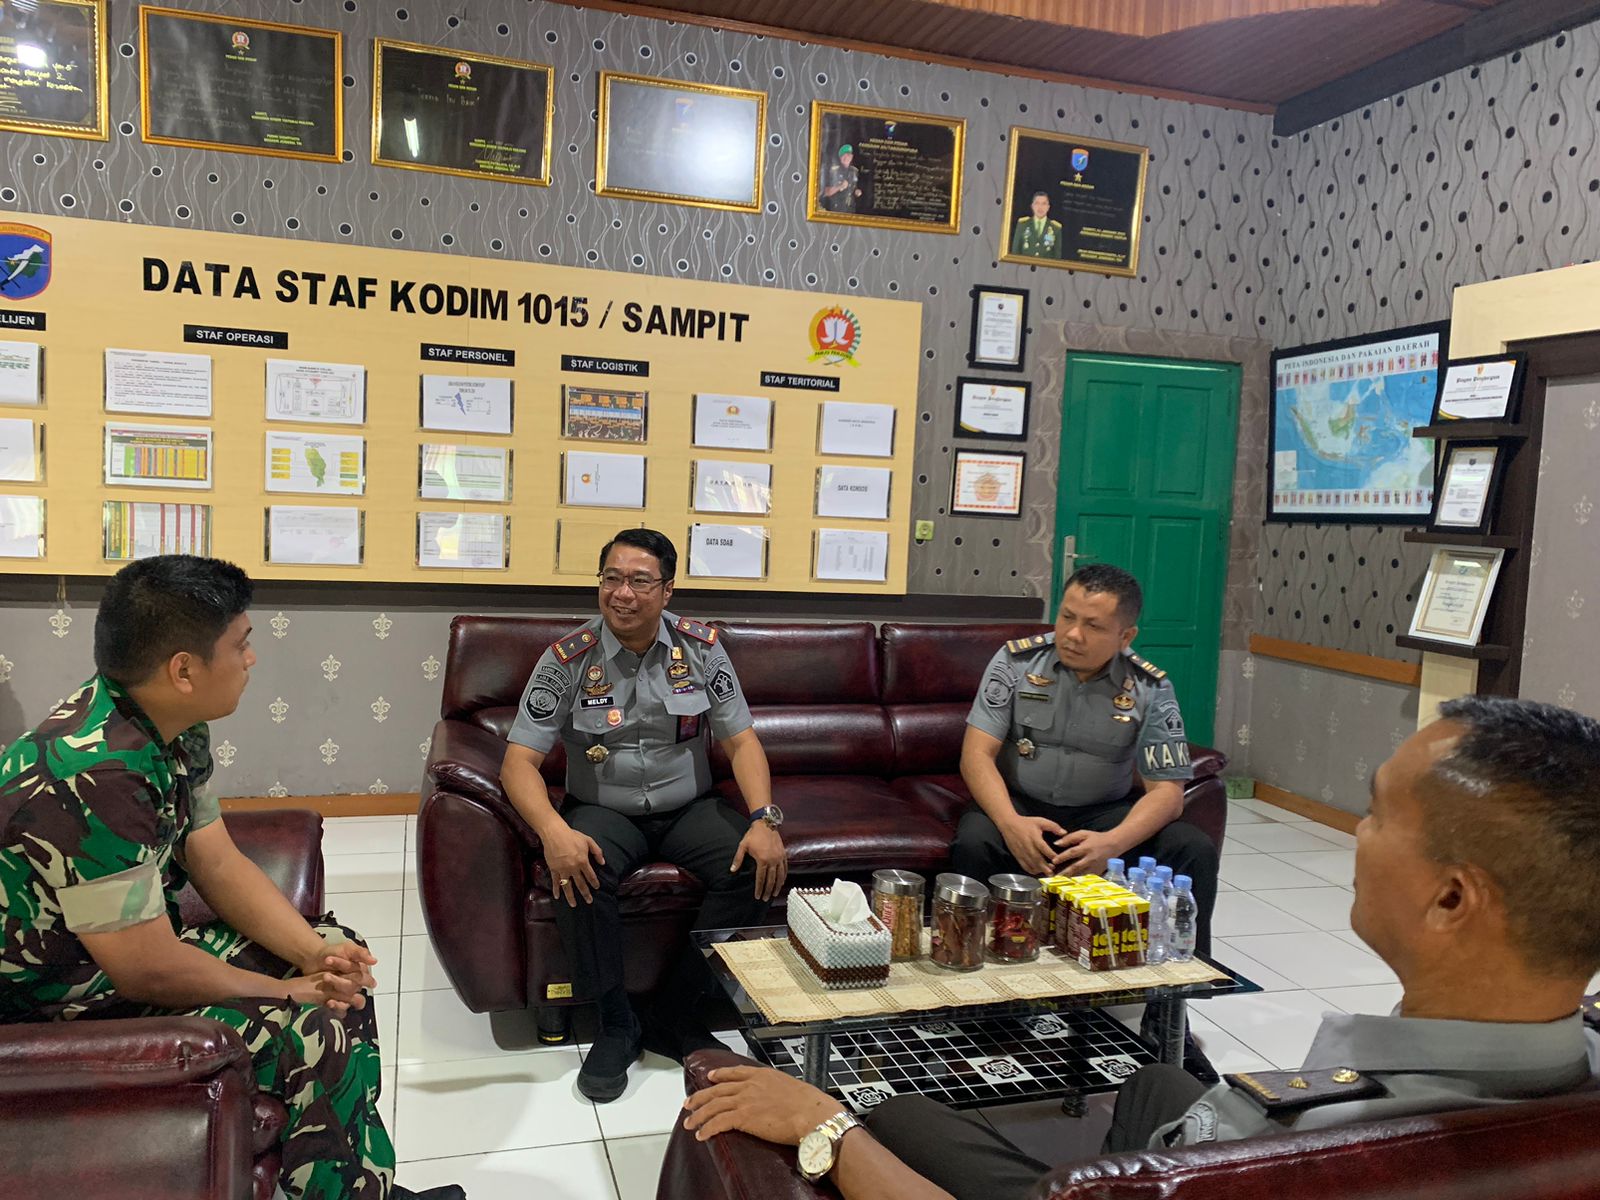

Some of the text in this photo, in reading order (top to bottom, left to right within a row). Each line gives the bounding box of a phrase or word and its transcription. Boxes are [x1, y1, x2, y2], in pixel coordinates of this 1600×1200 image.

[143, 257, 750, 343] DATA STAF KODIM 1015 / SAMPIT
[195, 328, 274, 344] STAF OPERASI
[428, 347, 508, 363] STAF PERSONEL
[1283, 361, 1300, 370] PETA
[1301, 355, 1339, 368] INDONESIA
[1340, 351, 1356, 361] DAN
[1394, 340, 1430, 352] DAERAH
[570, 359, 638, 373] STAF LOGISTIK
[764, 375, 836, 388] STAF TERITORIAL
[705, 538, 719, 546] DATA
[1144, 741, 1191, 770] KAK
